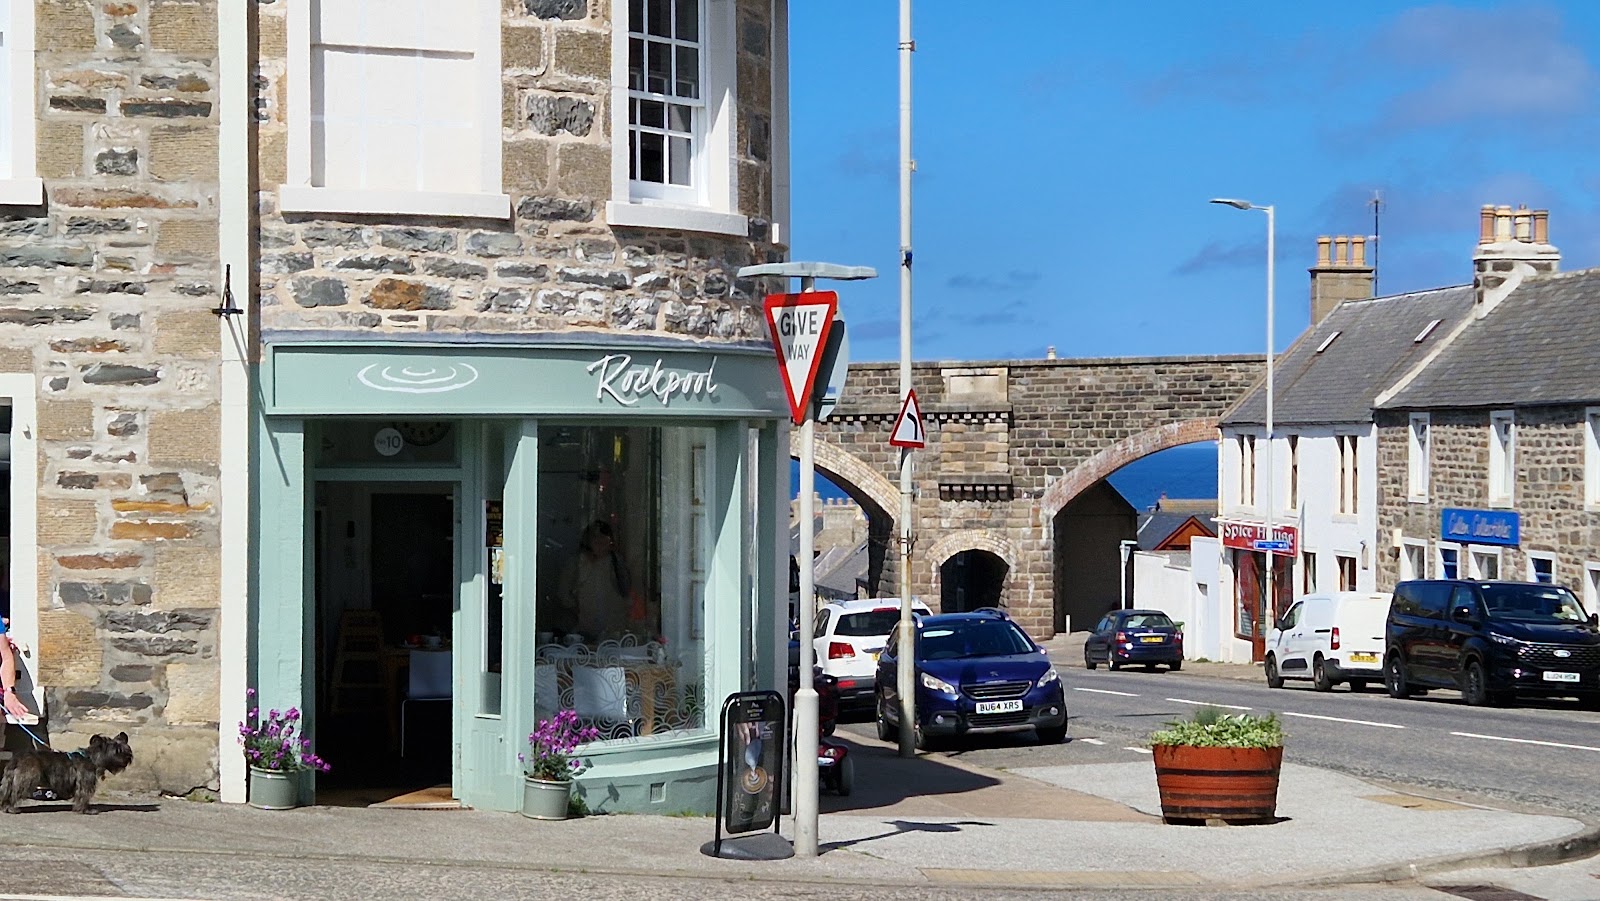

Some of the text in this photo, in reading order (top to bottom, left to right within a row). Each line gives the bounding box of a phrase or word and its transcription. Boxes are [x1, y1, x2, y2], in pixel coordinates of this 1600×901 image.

[781, 311, 818, 337] GIVE
[788, 344, 810, 361] WAY
[586, 354, 718, 404] Rockpool
[1224, 523, 1294, 546] Spice Huse
[979, 701, 1020, 712] BU64 XRS
